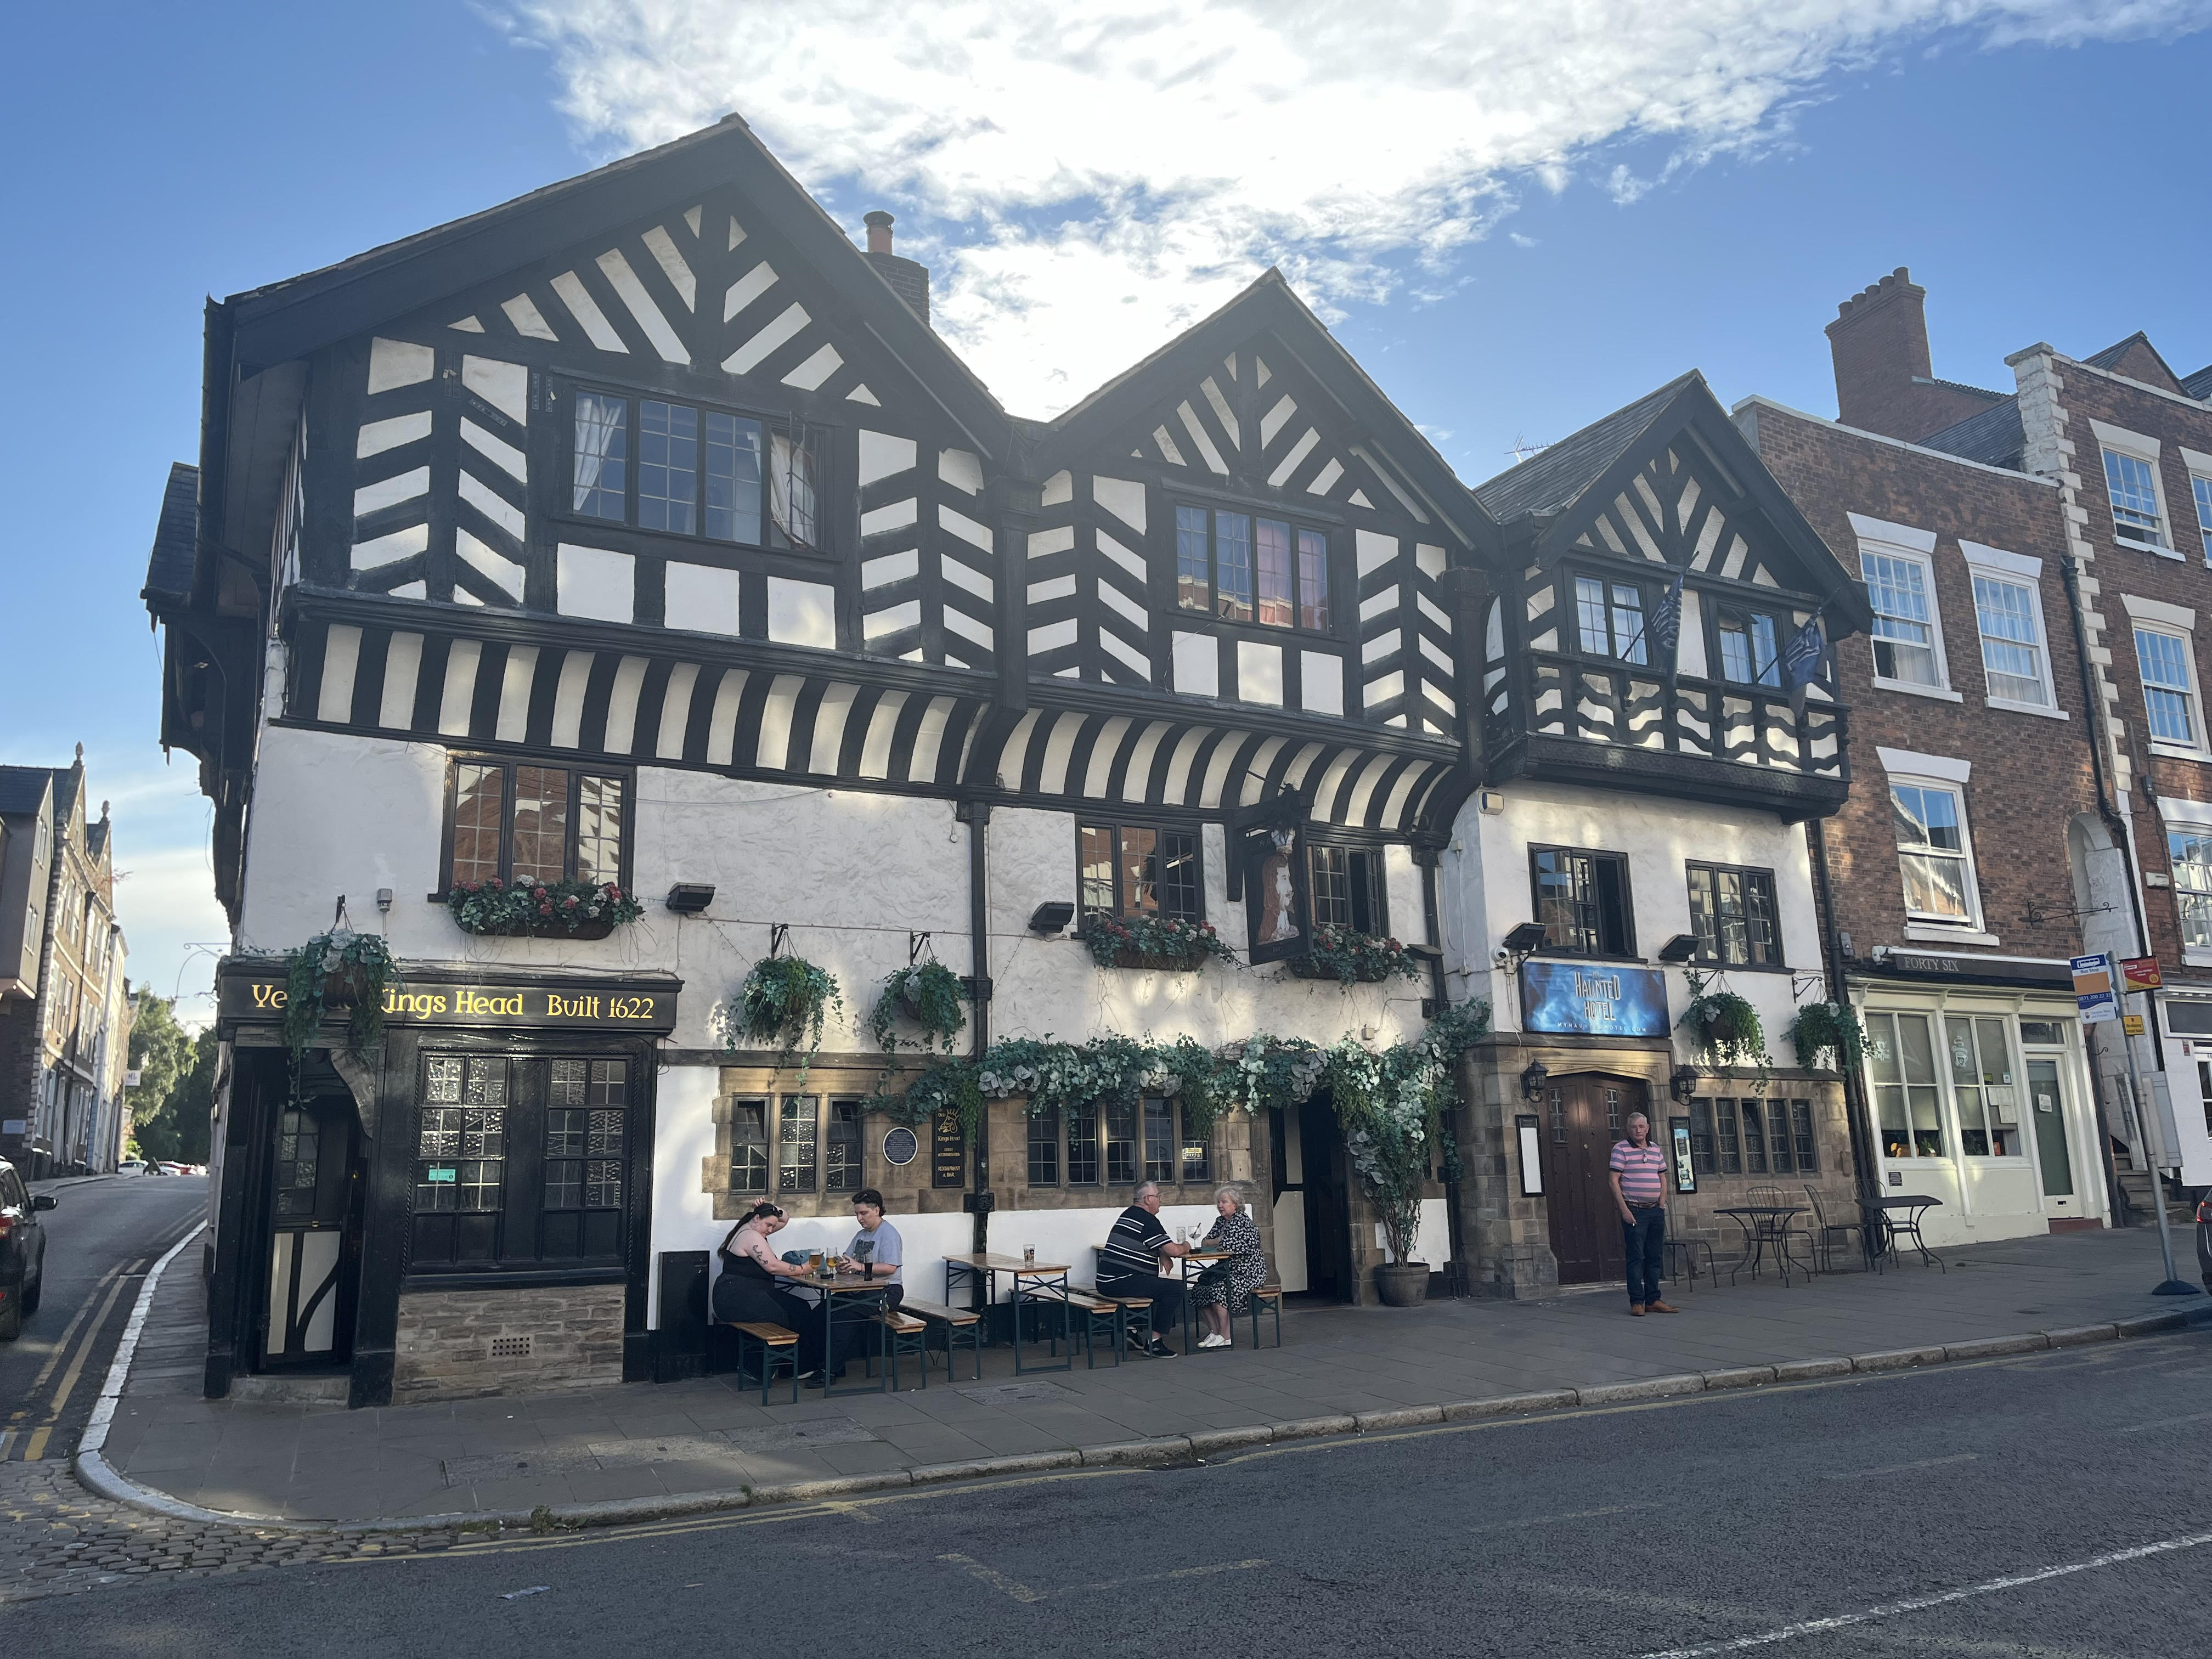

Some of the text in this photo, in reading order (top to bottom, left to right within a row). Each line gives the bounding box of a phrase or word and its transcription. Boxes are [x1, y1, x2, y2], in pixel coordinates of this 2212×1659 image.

[1904, 957, 1959, 972] FORTY SIX
[1574, 971, 1621, 1000] HAUNTED
[251, 984, 288, 1009] Ye
[454, 991, 524, 1015] Head
[546, 994, 600, 1019] Built
[607, 997, 654, 1019] 1622
[1584, 1000, 1616, 1021] HOTEL
